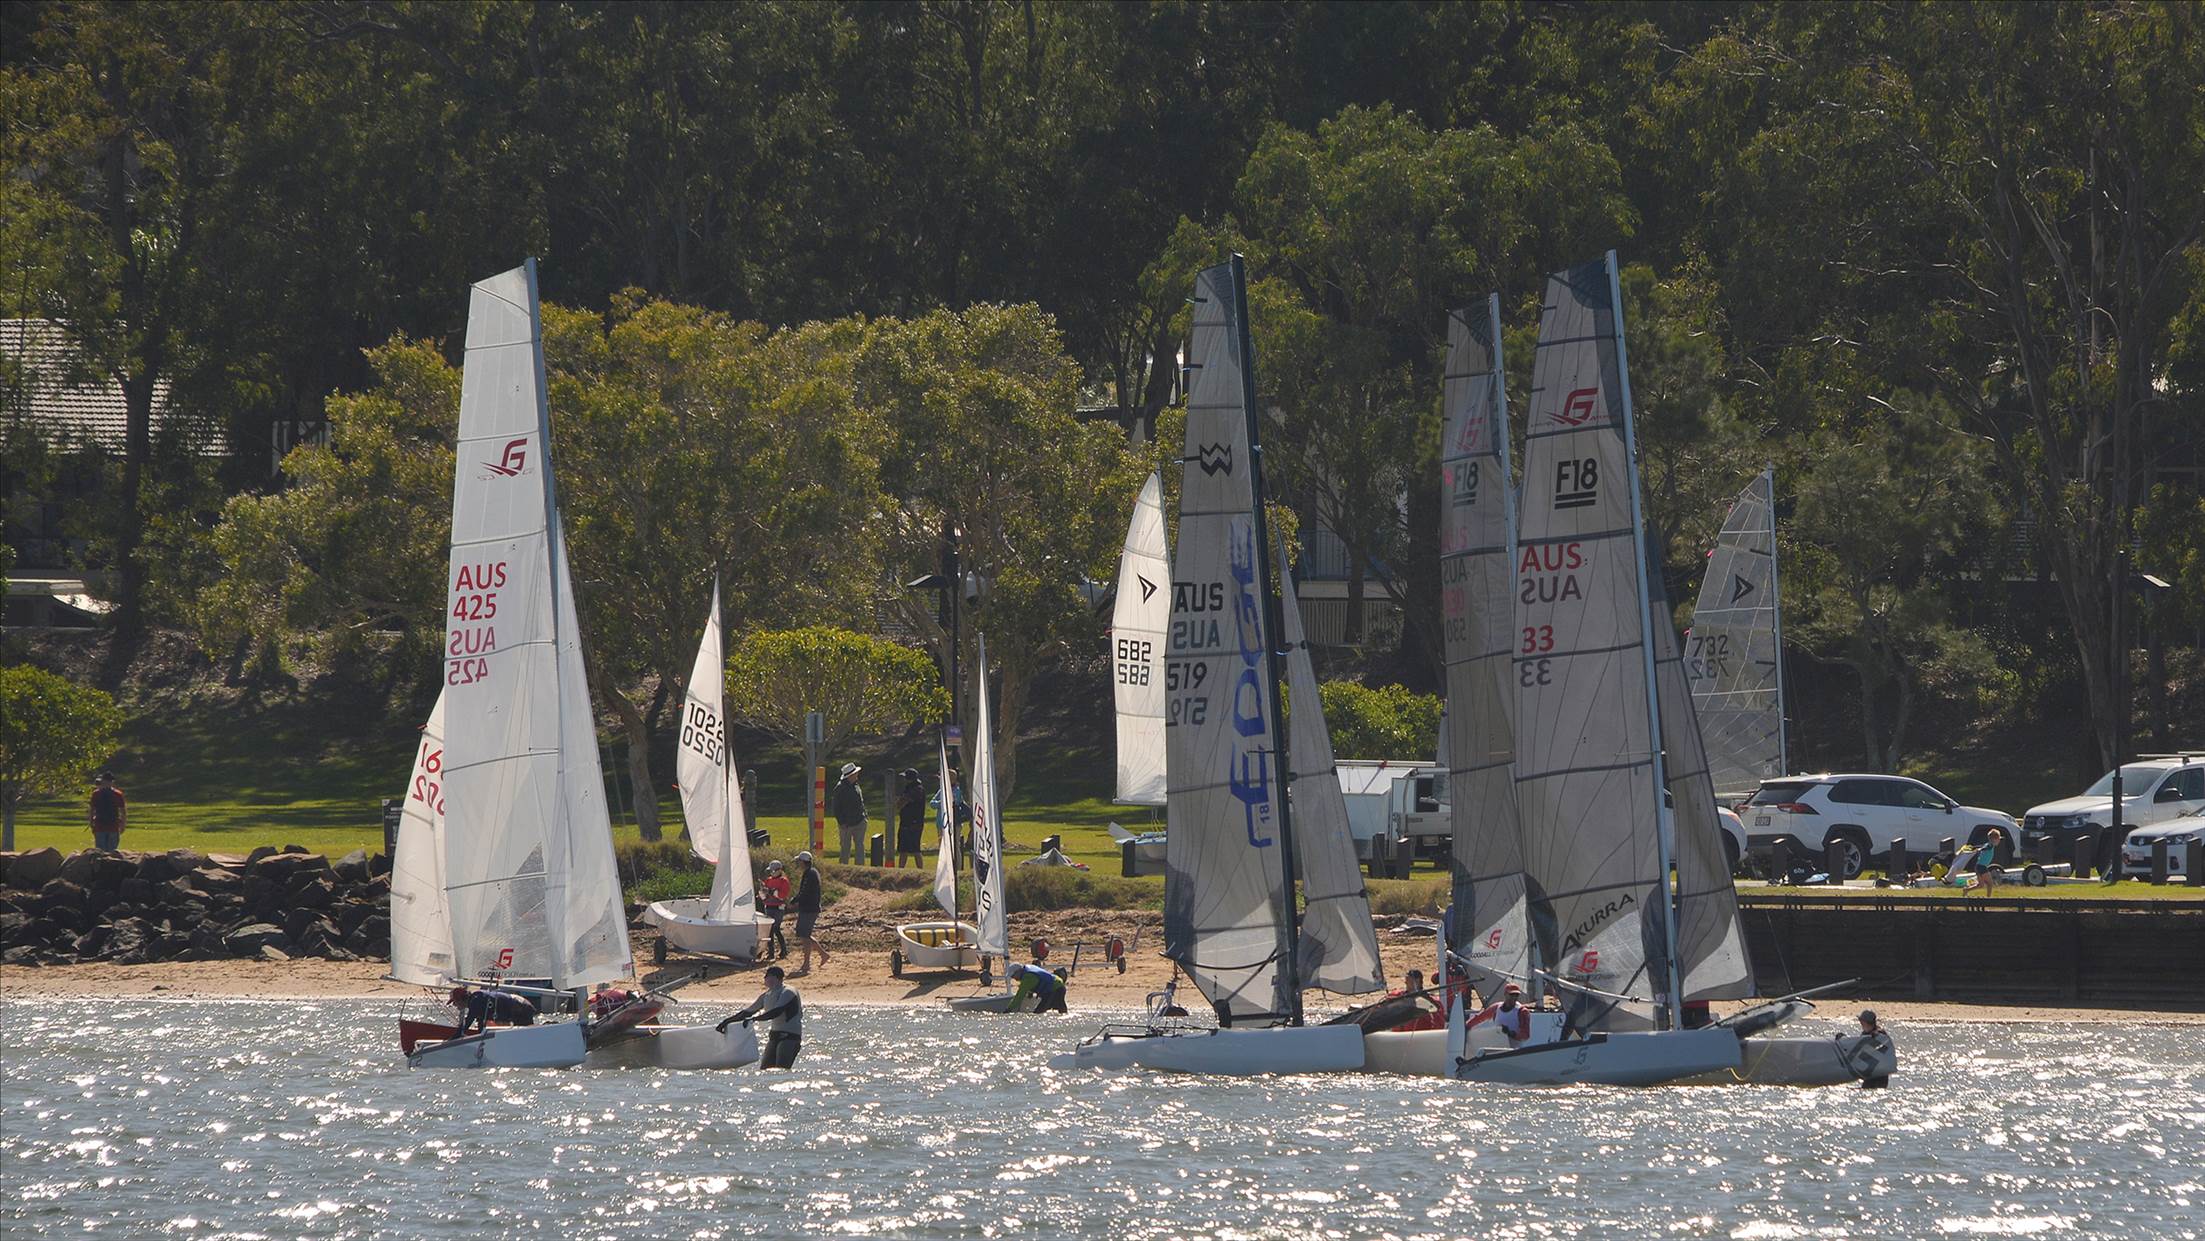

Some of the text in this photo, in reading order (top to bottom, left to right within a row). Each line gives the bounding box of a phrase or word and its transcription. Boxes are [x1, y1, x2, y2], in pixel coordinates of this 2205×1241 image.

[1454, 461, 1479, 492] F18
[1555, 458, 1598, 493] F18
[1520, 543, 1582, 574] AUS
[455, 562, 507, 591] AUS
[453, 593, 497, 621] 425
[1173, 582, 1224, 613] AUS
[1118, 639, 1151, 662] 682
[1521, 625, 1554, 654] 33
[1692, 634, 1729, 657] 732
[1167, 662, 1208, 691] 519
[1259, 804, 1270, 824] 18
[1561, 893, 1634, 959] AKURRA
